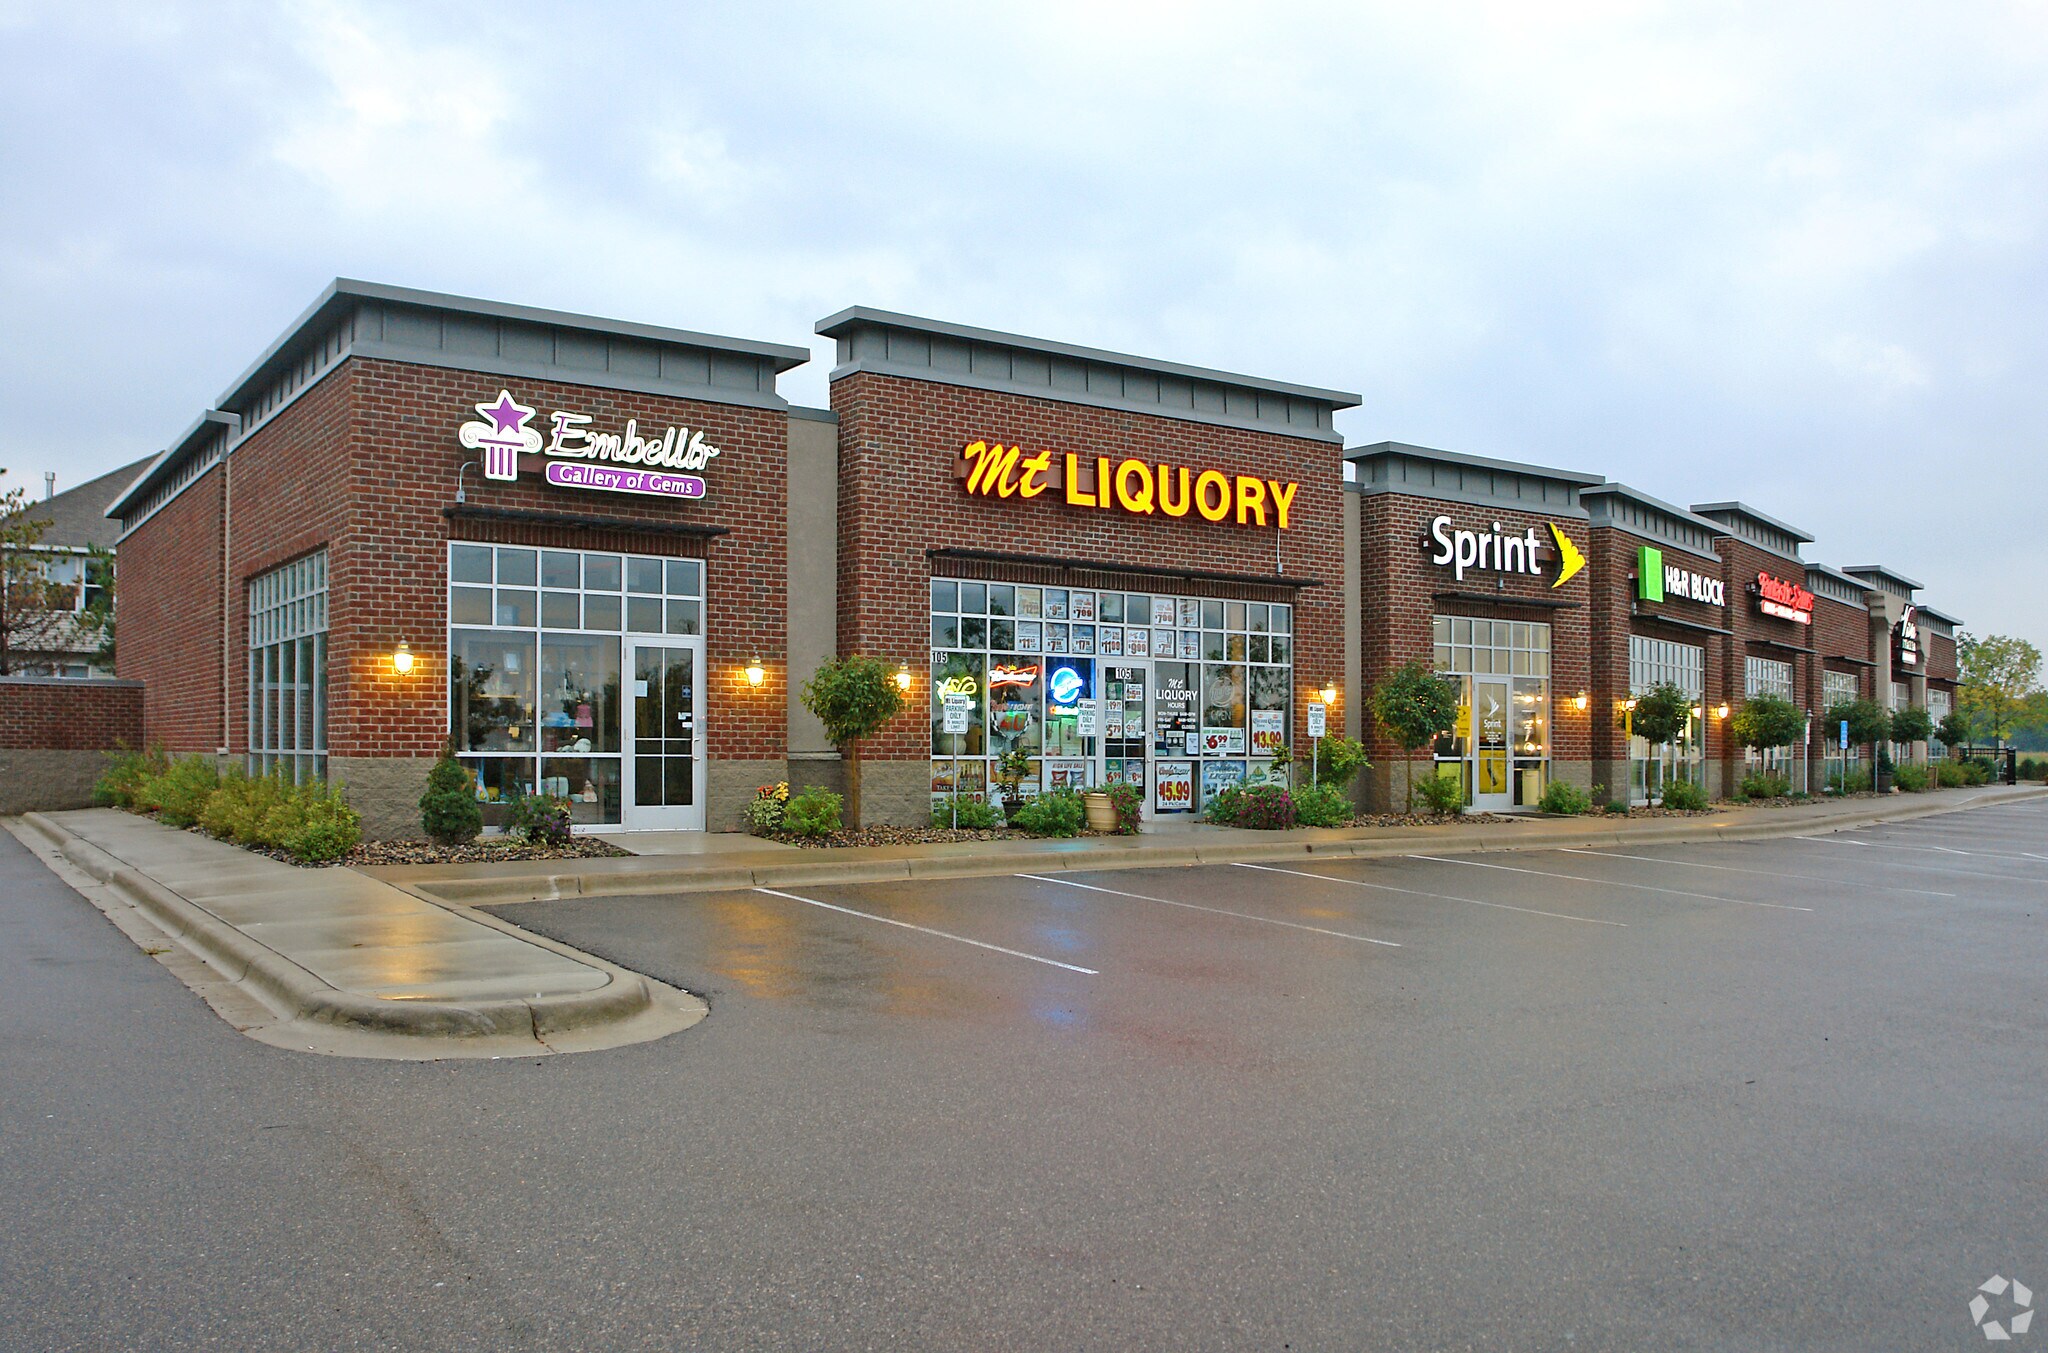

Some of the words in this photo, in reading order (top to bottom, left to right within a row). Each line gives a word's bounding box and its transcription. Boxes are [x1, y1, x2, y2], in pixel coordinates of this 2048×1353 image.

[559, 465, 621, 489] Gallery
[626, 473, 644, 489] of
[649, 475, 693, 494] Gems
[964, 440, 1051, 499] Mt
[1065, 452, 1298, 529] LIQUORY
[1432, 515, 1542, 581] Sprint
[1664, 565, 1690, 599] H&R
[1691, 573, 1726, 607] BLOCK
[932, 652, 947, 663] 105
[1117, 668, 1131, 679] 105
[1168, 678, 1183, 689] Mt
[1156, 689, 1198, 701] LIQUORY
[1211, 710, 1232, 721] OPEN
[1484, 719, 1502, 730] Sprint
